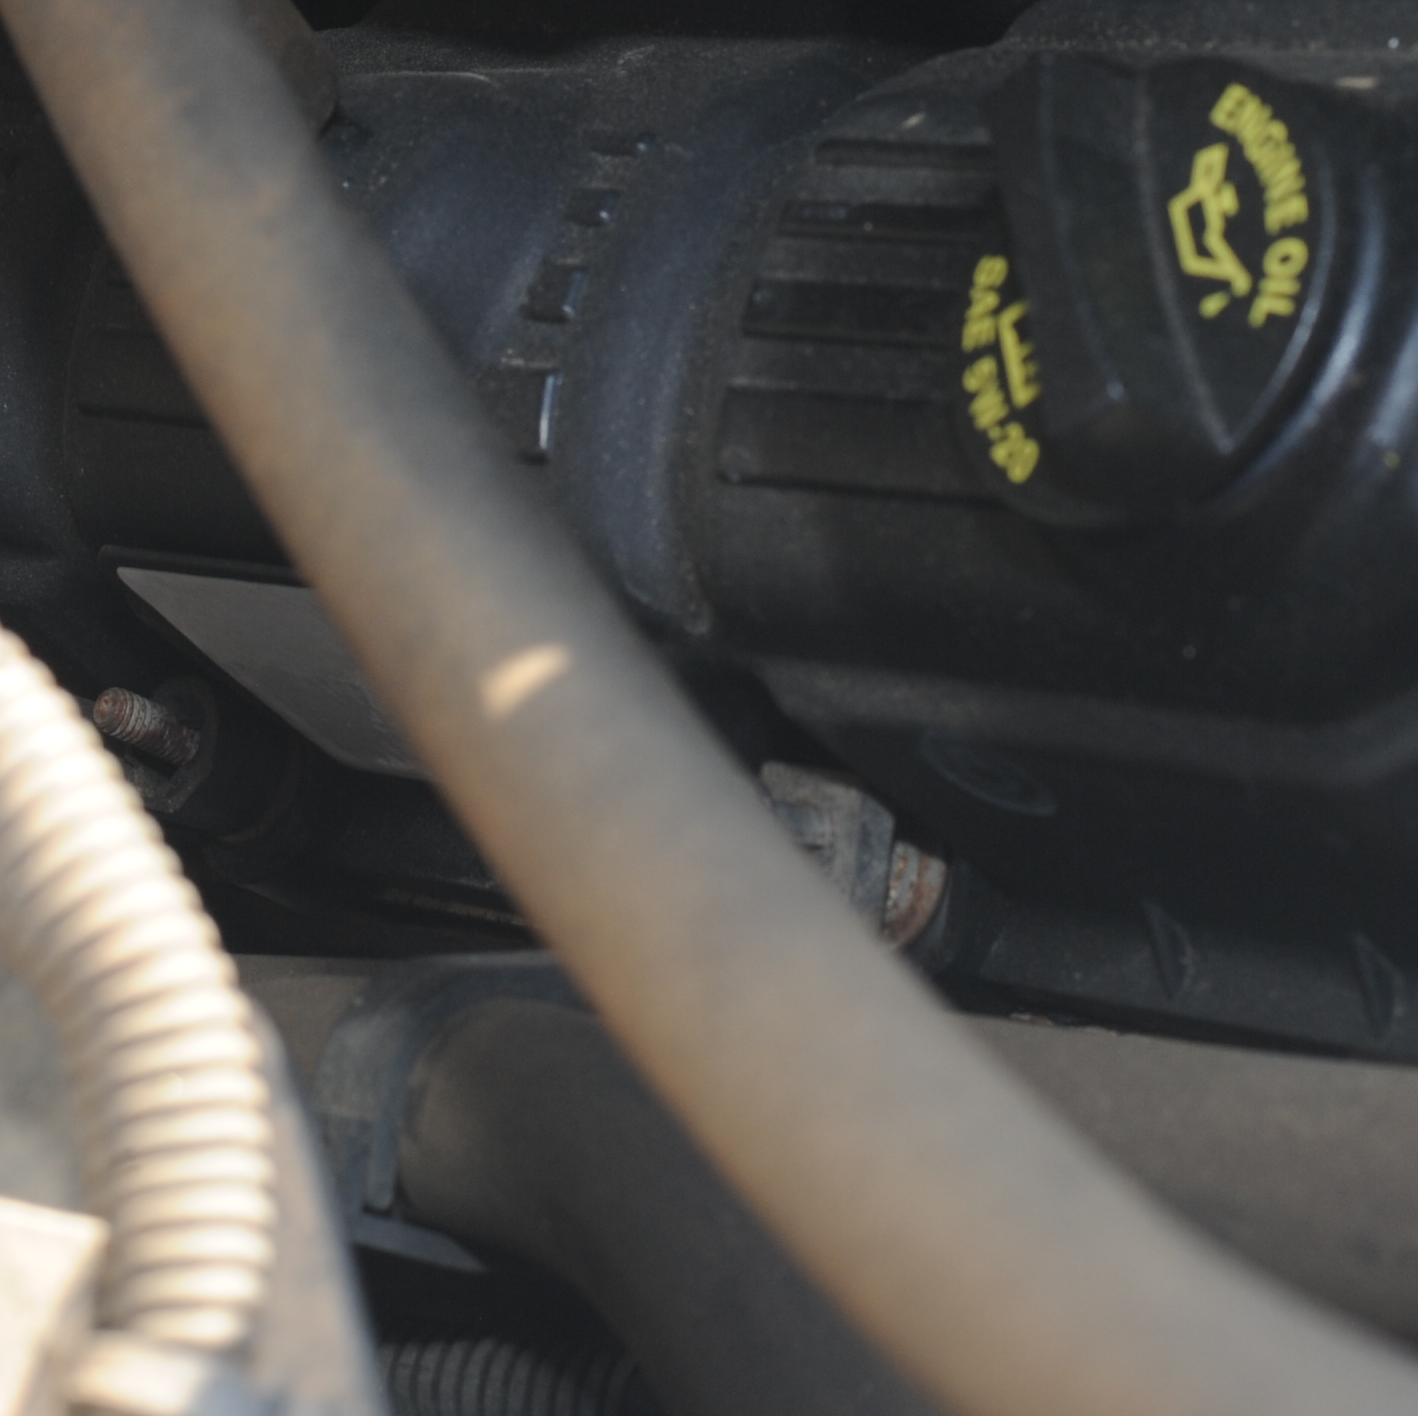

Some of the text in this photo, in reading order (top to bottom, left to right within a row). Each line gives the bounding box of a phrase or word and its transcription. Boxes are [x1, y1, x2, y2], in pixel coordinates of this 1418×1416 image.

[1212, 83, 1310, 327] ENGINE OIL
[960, 255, 1009, 353] SAE
